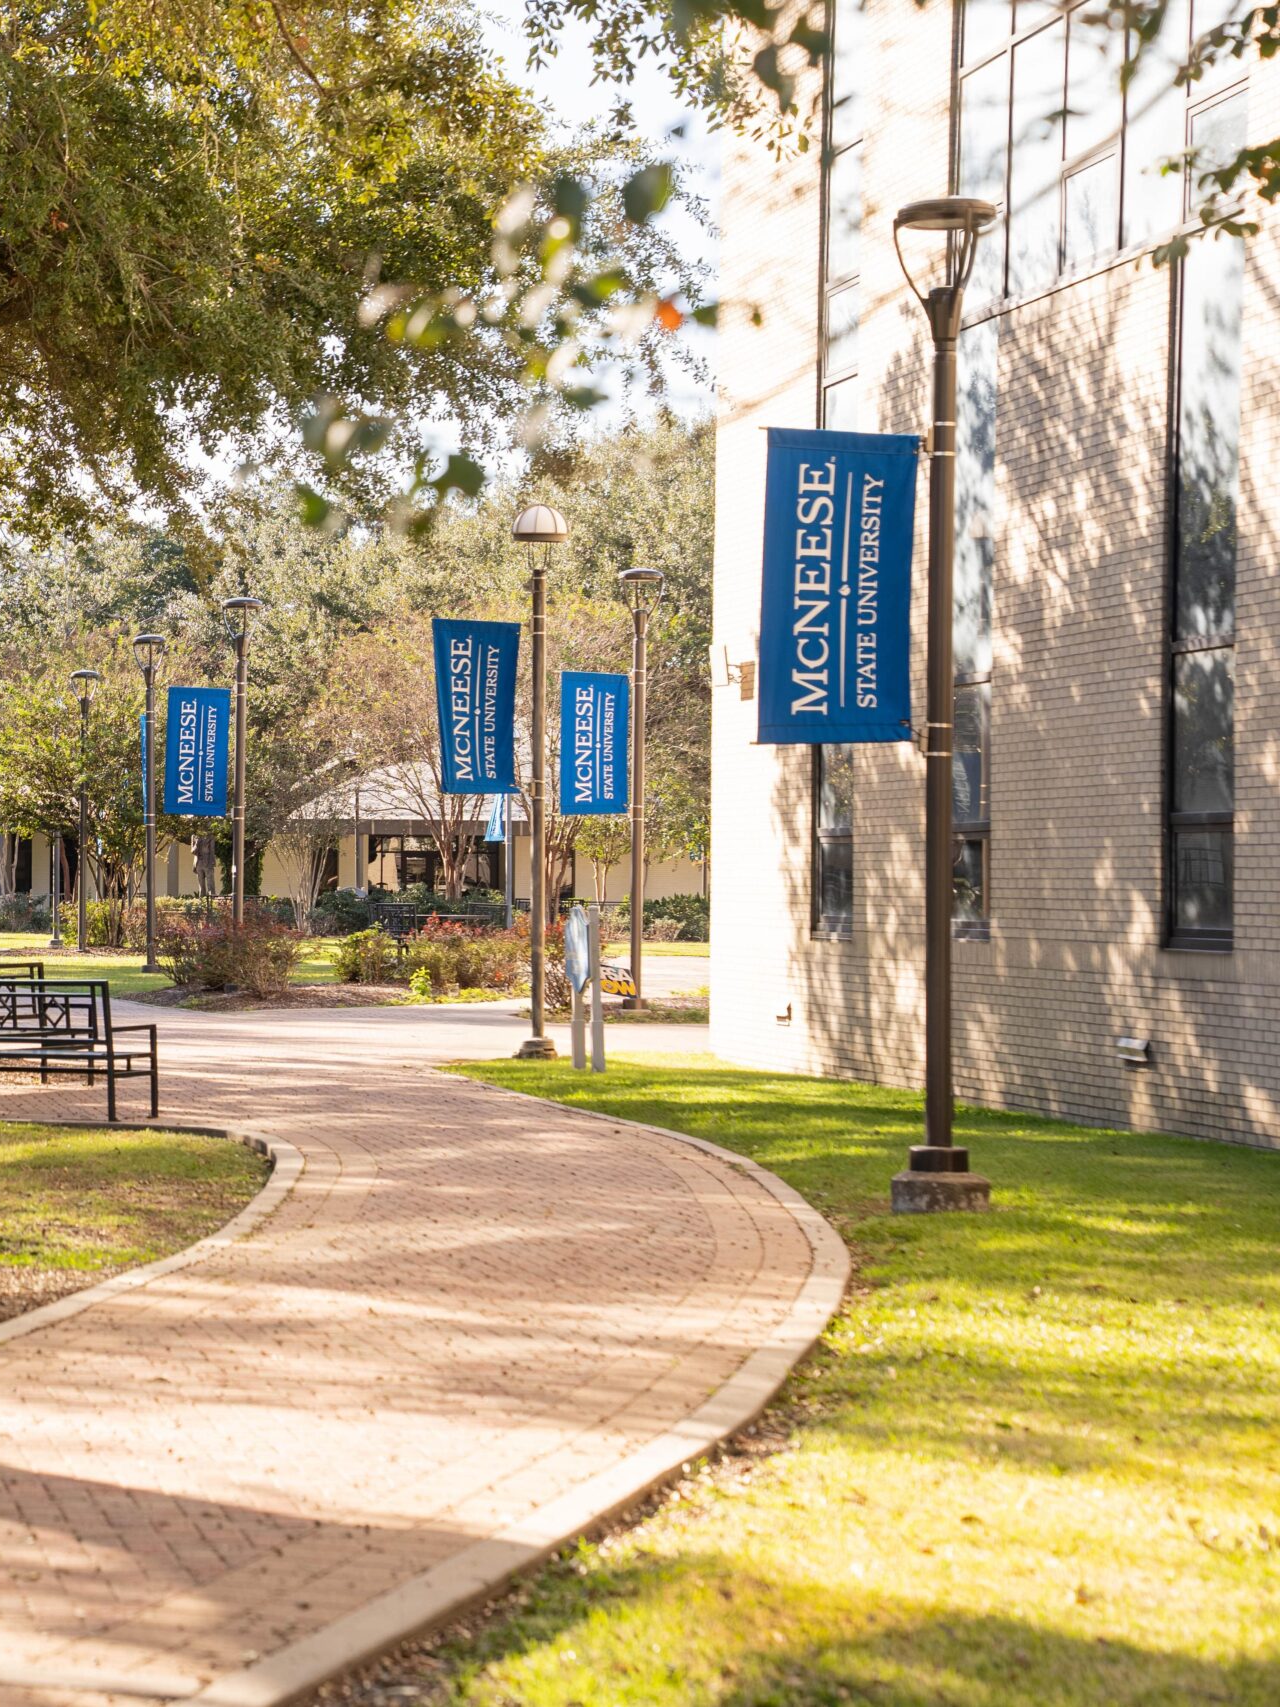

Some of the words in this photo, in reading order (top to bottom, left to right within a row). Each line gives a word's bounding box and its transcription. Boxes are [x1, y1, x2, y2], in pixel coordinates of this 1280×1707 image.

[857, 473, 884, 626] UNIVERSITY
[484, 645, 500, 732] UNIVERSITY
[857, 632, 877, 708] STATE
[205, 705, 217, 768] UNIVERSITY
[484, 735, 497, 779] STATE
[603, 692, 615, 762] UNIVERSITY
[205, 770, 214, 802] STATE
[603, 764, 614, 800] STATE
